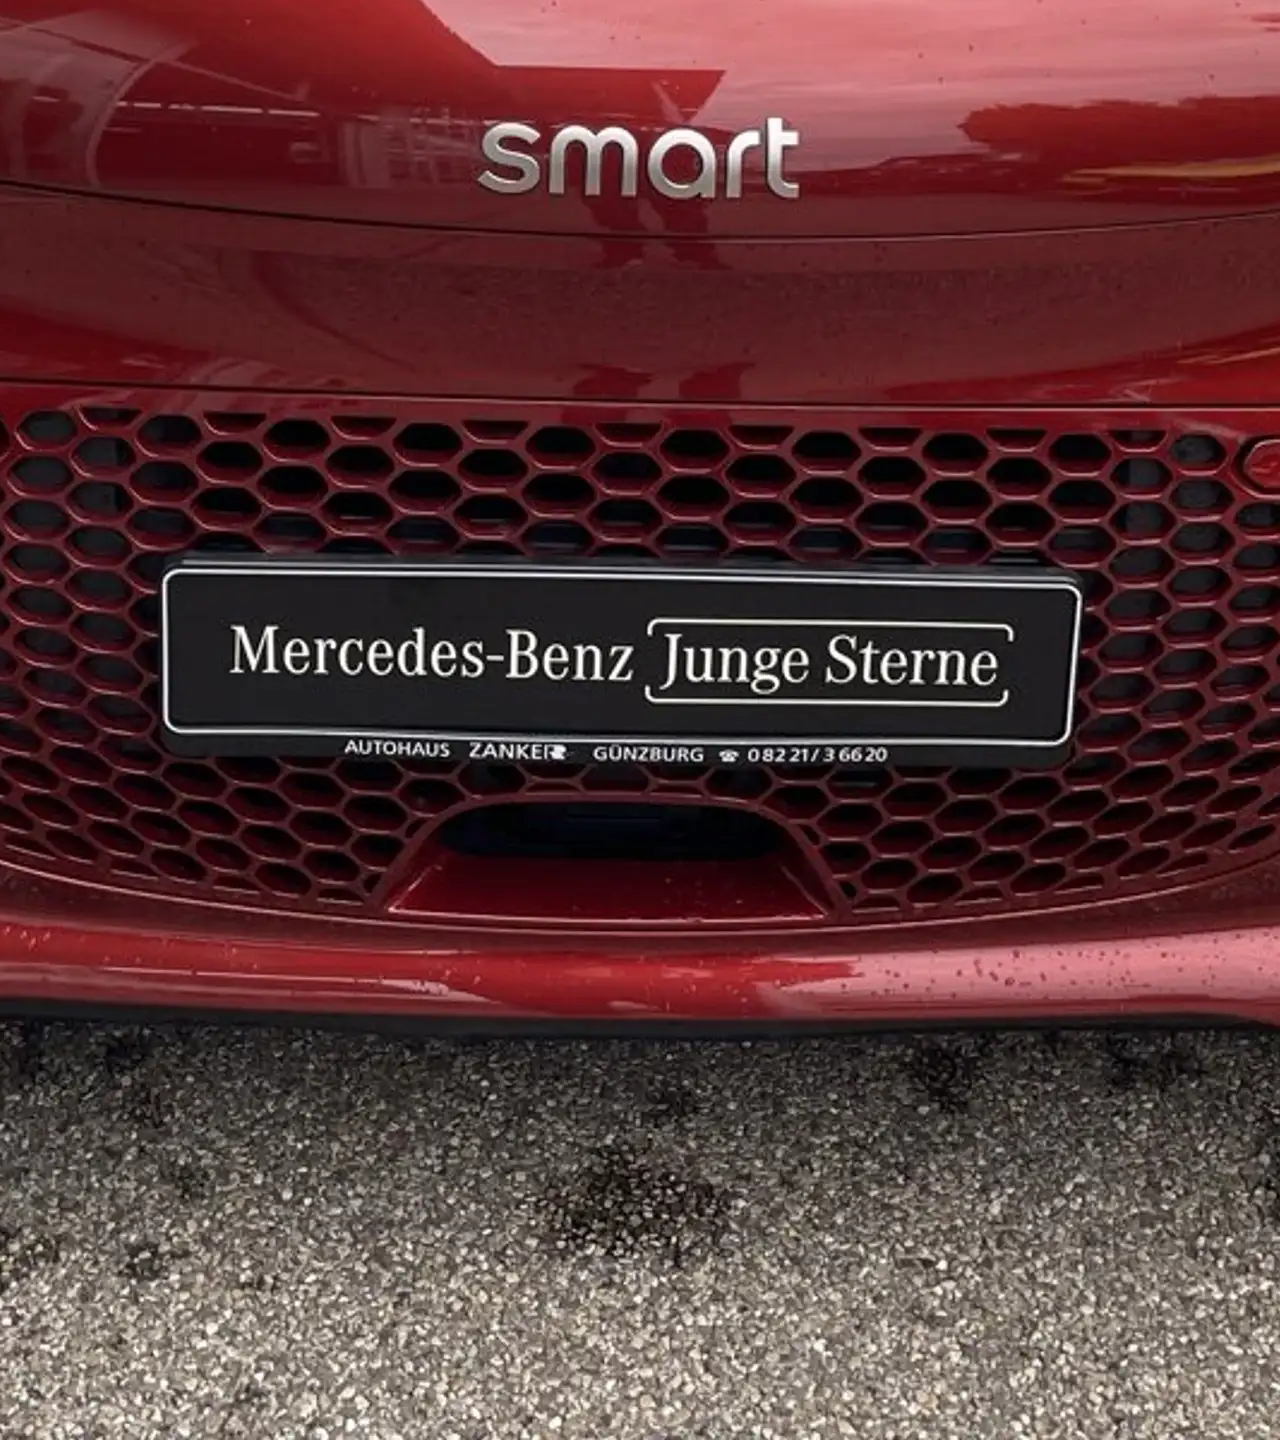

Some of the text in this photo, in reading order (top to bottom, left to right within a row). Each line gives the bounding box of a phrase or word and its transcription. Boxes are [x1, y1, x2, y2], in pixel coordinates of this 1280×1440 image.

[477, 117, 799, 199] smart
[230, 624, 998, 695] Mercedes-Benz Junge Sterne
[344, 739, 451, 758] AUTOHAUS
[469, 742, 567, 760] ZANKER
[593, 744, 705, 762] GÜNZBURG
